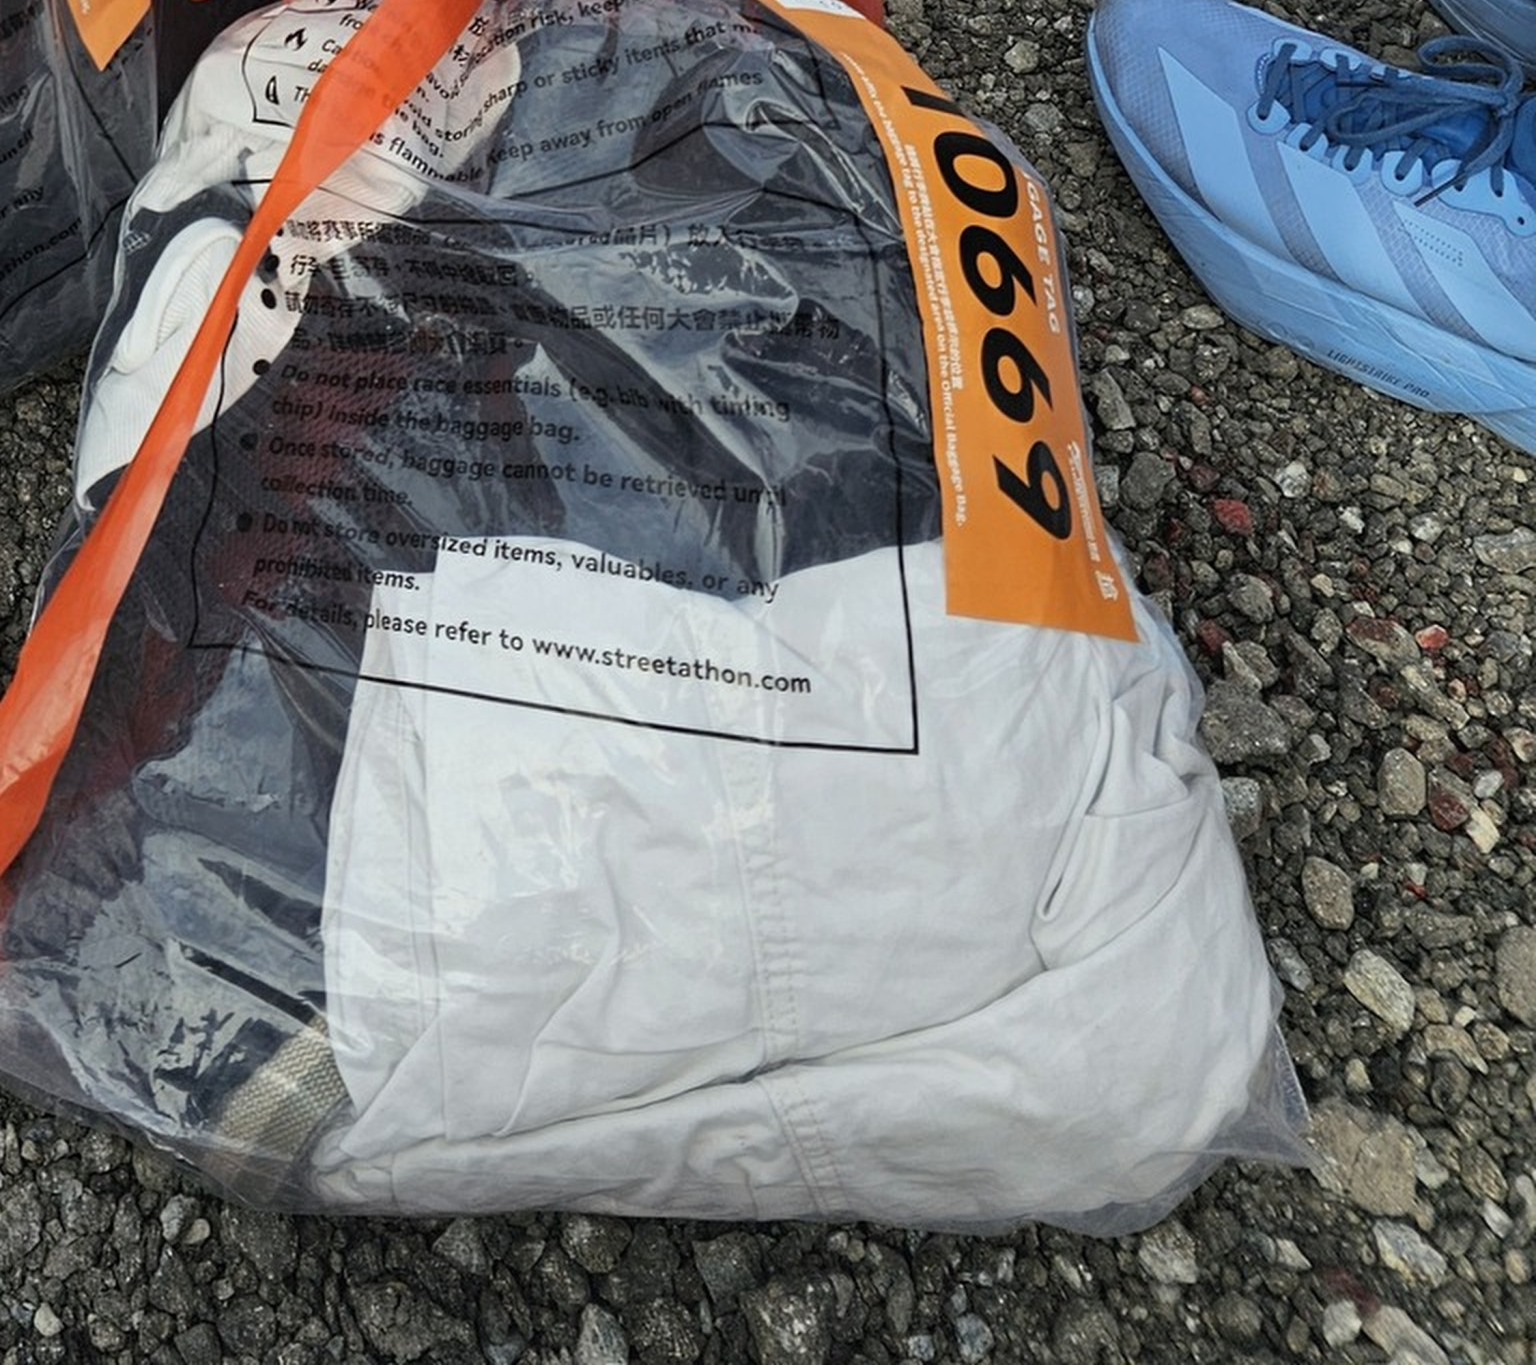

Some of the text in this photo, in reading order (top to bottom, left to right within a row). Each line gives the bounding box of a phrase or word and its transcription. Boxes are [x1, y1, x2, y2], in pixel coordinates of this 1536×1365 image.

[482, 22, 727, 113] sharp or sticky that
[540, 113, 647, 158] away from
[1043, 271, 1061, 336] TAG
[412, 375, 562, 400] race essentials
[327, 404, 582, 445] inside the baggage bag.
[261, 471, 415, 506] collection time.
[268, 435, 727, 504] Once cannot be retrieved
[361, 569, 421, 593] items.
[385, 527, 780, 604] oversized items, valuables, or any
[284, 596, 813, 696] details, please refer to www.streetathon.com
